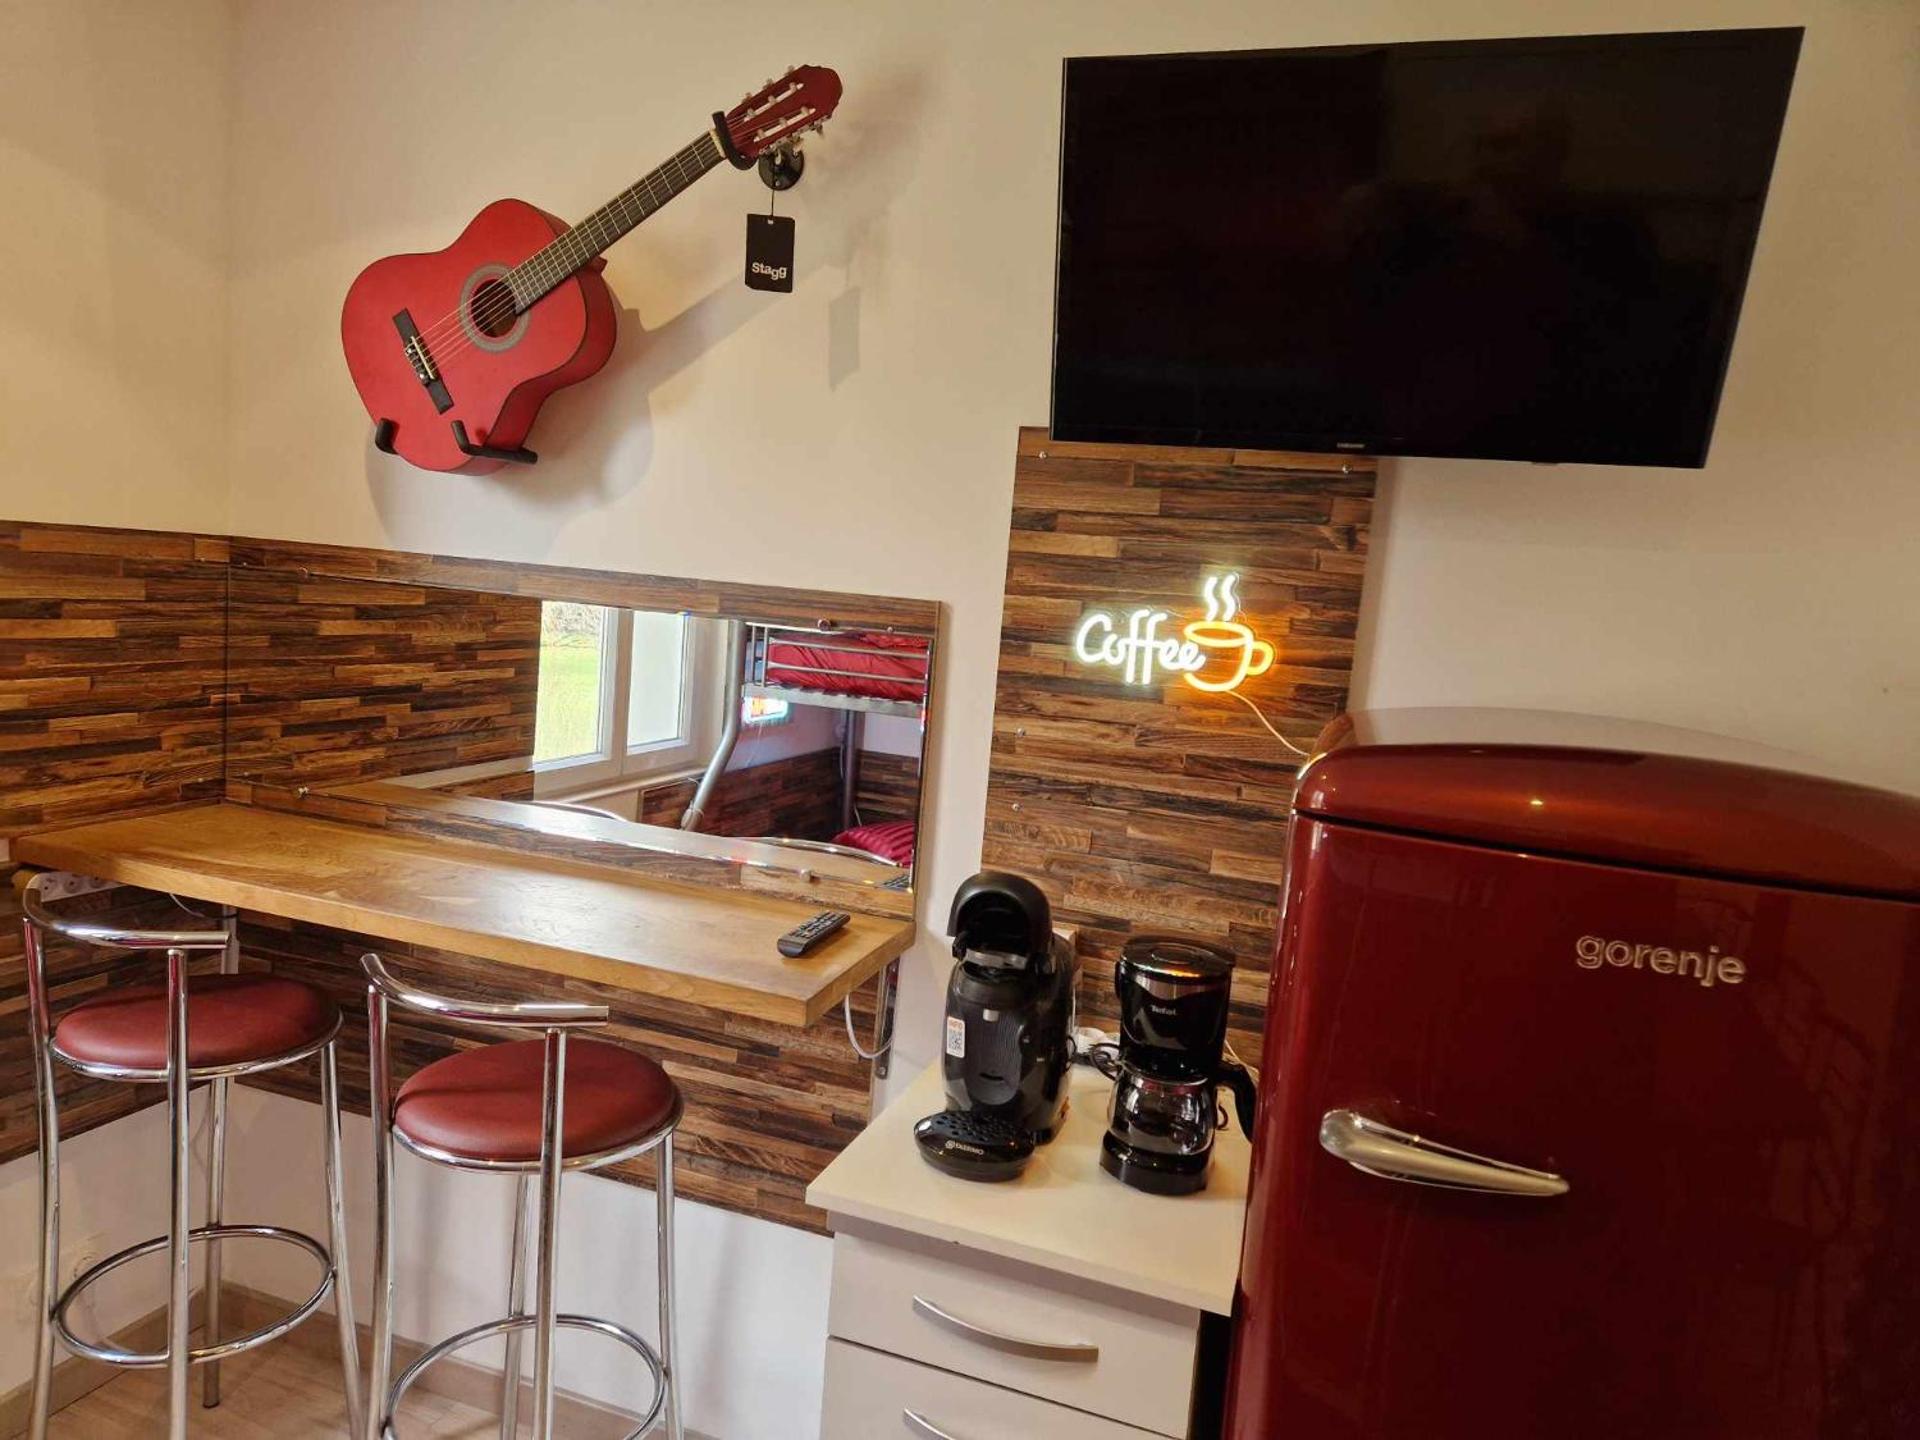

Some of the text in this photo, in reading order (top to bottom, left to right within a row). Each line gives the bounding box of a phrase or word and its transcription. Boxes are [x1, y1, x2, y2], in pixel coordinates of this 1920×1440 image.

[751, 262, 787, 280] Stagg
[1076, 609, 1206, 685] Coffee
[1576, 935, 1746, 987] gorenje
